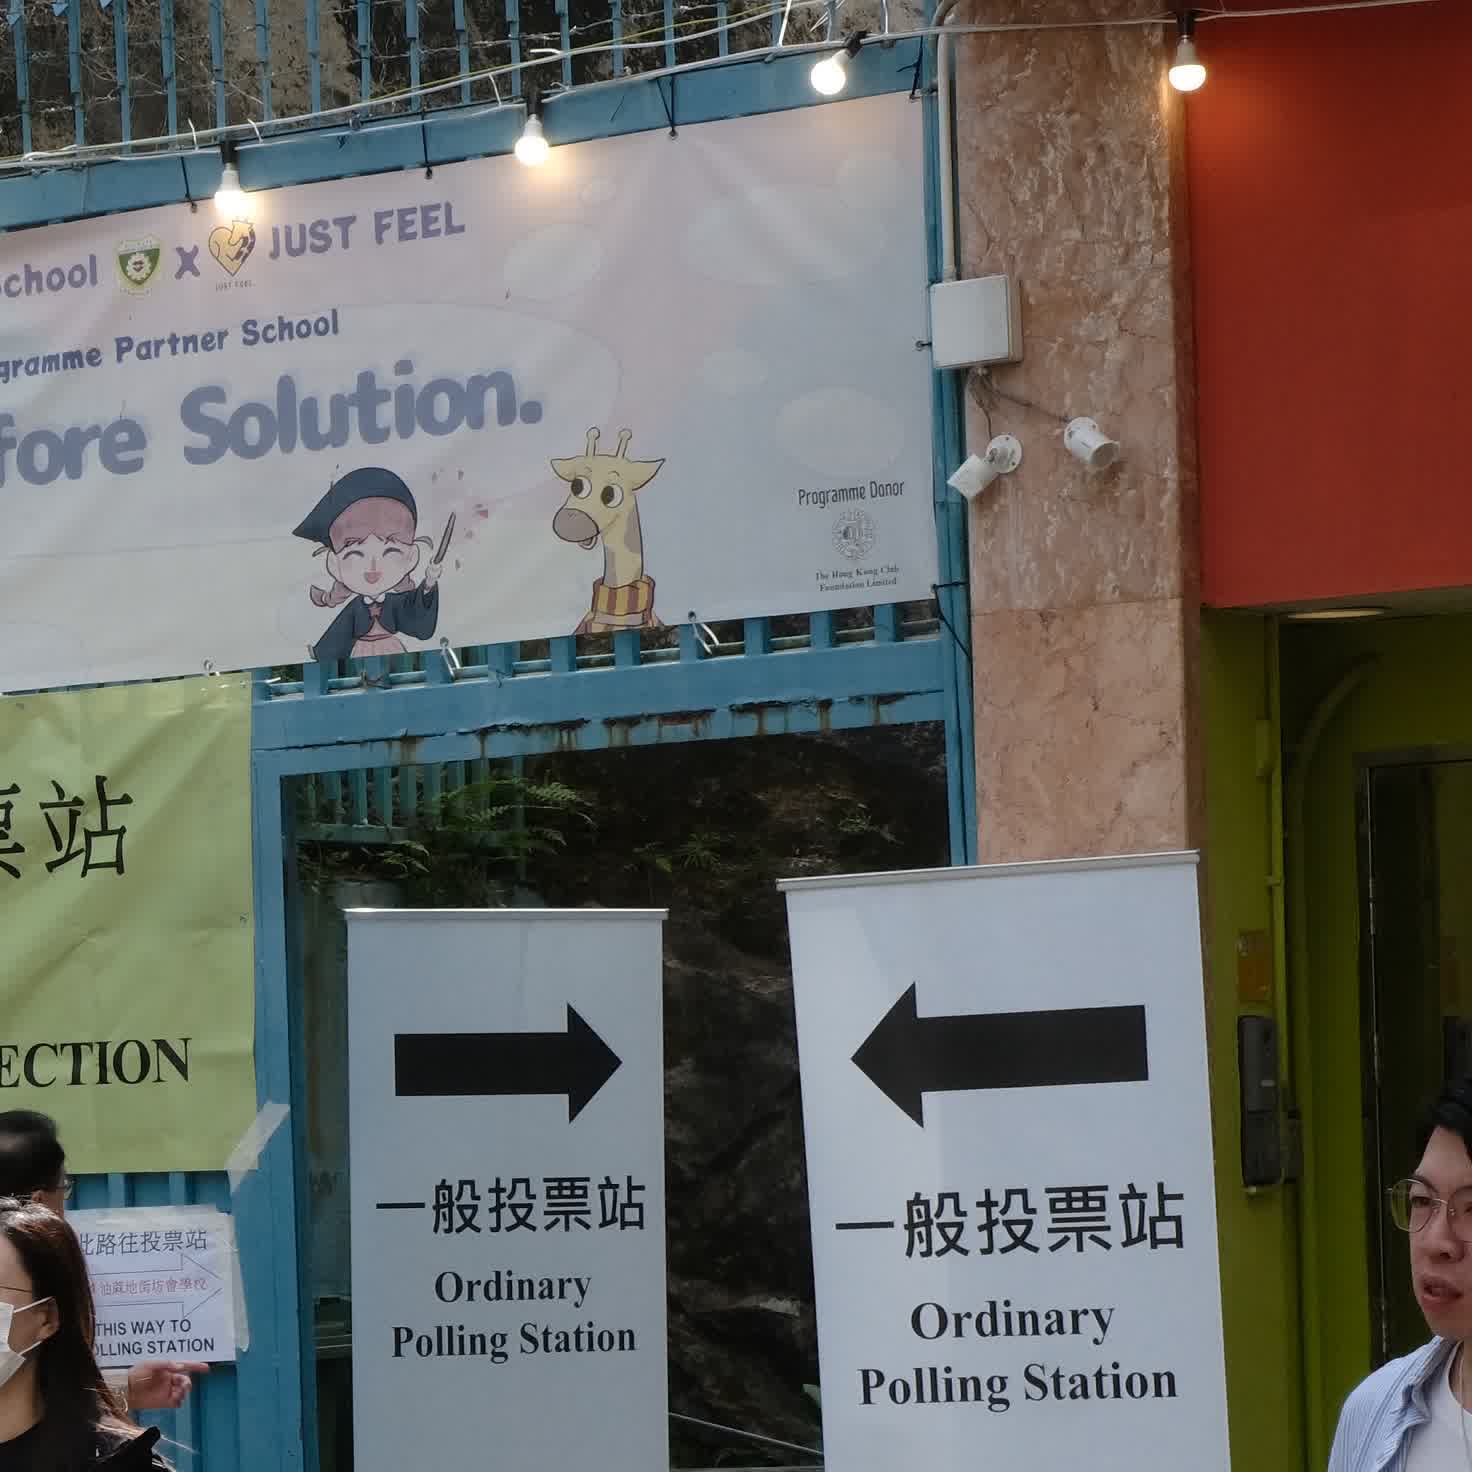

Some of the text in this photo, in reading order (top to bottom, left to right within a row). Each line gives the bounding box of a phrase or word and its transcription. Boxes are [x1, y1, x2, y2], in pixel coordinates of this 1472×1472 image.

[269, 213, 356, 262] JUST
[374, 200, 466, 245] FEEL
[114, 327, 229, 364] Partner
[241, 307, 341, 346] School
[181, 360, 545, 467] Solution.
[798, 480, 905, 509] Programme Donor
[375, 1174, 646, 1235] 一般投票站
[834, 1182, 1185, 1259] 一般投票站
[434, 1269, 592, 1309] Ordinary
[96, 1318, 192, 1338] THIS WAY TO
[146, 1337, 215, 1356] STATION
[390, 1321, 637, 1365] Polling Station
[910, 1299, 1116, 1346] Ordinary
[857, 1362, 1178, 1413] Polling Station
